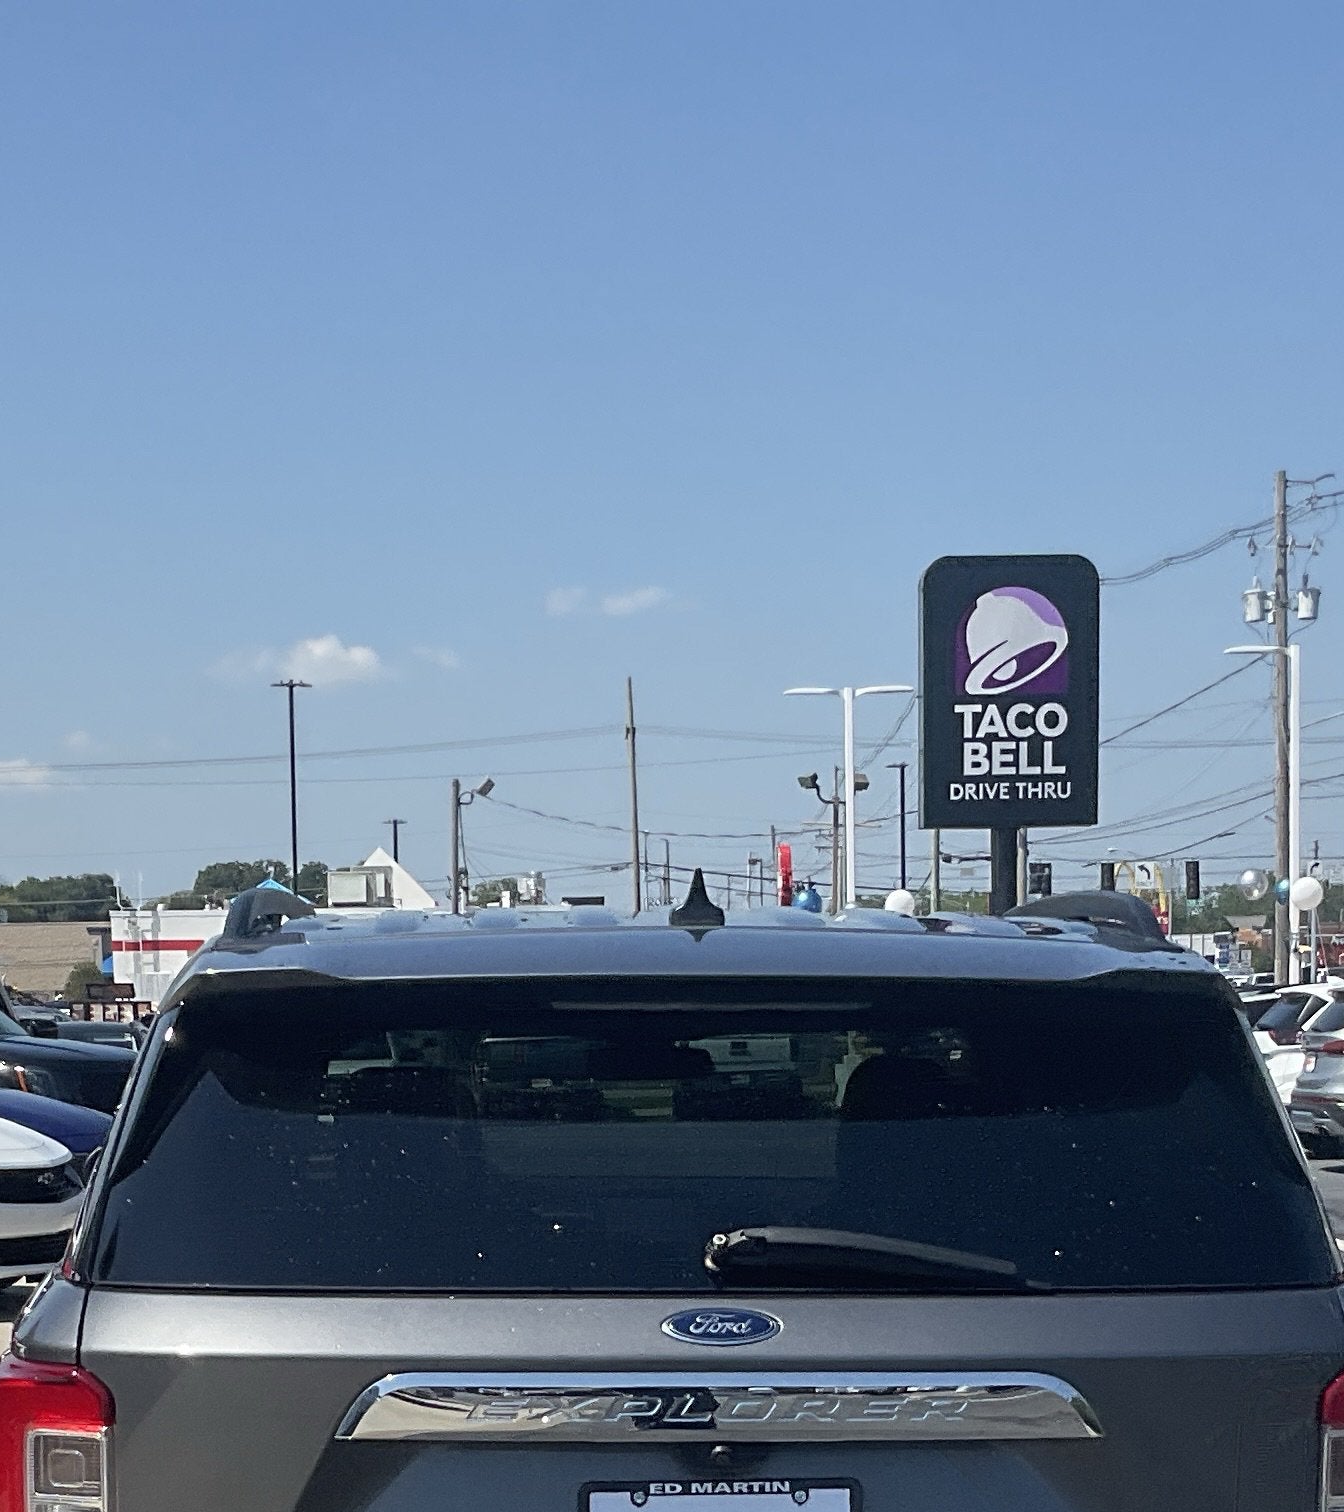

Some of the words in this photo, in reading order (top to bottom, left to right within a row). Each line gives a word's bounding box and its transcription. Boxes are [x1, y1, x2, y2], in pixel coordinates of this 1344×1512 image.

[954, 702, 1069, 739] TACO
[963, 741, 1066, 776] BELL
[949, 783, 1010, 800] DRIVE
[1016, 781, 1072, 799] THRU
[690, 1313, 752, 1335] Ford
[465, 1396, 970, 1424] EXPLORER
[649, 1482, 681, 1495] ED
[691, 1480, 791, 1494] MARTIN
